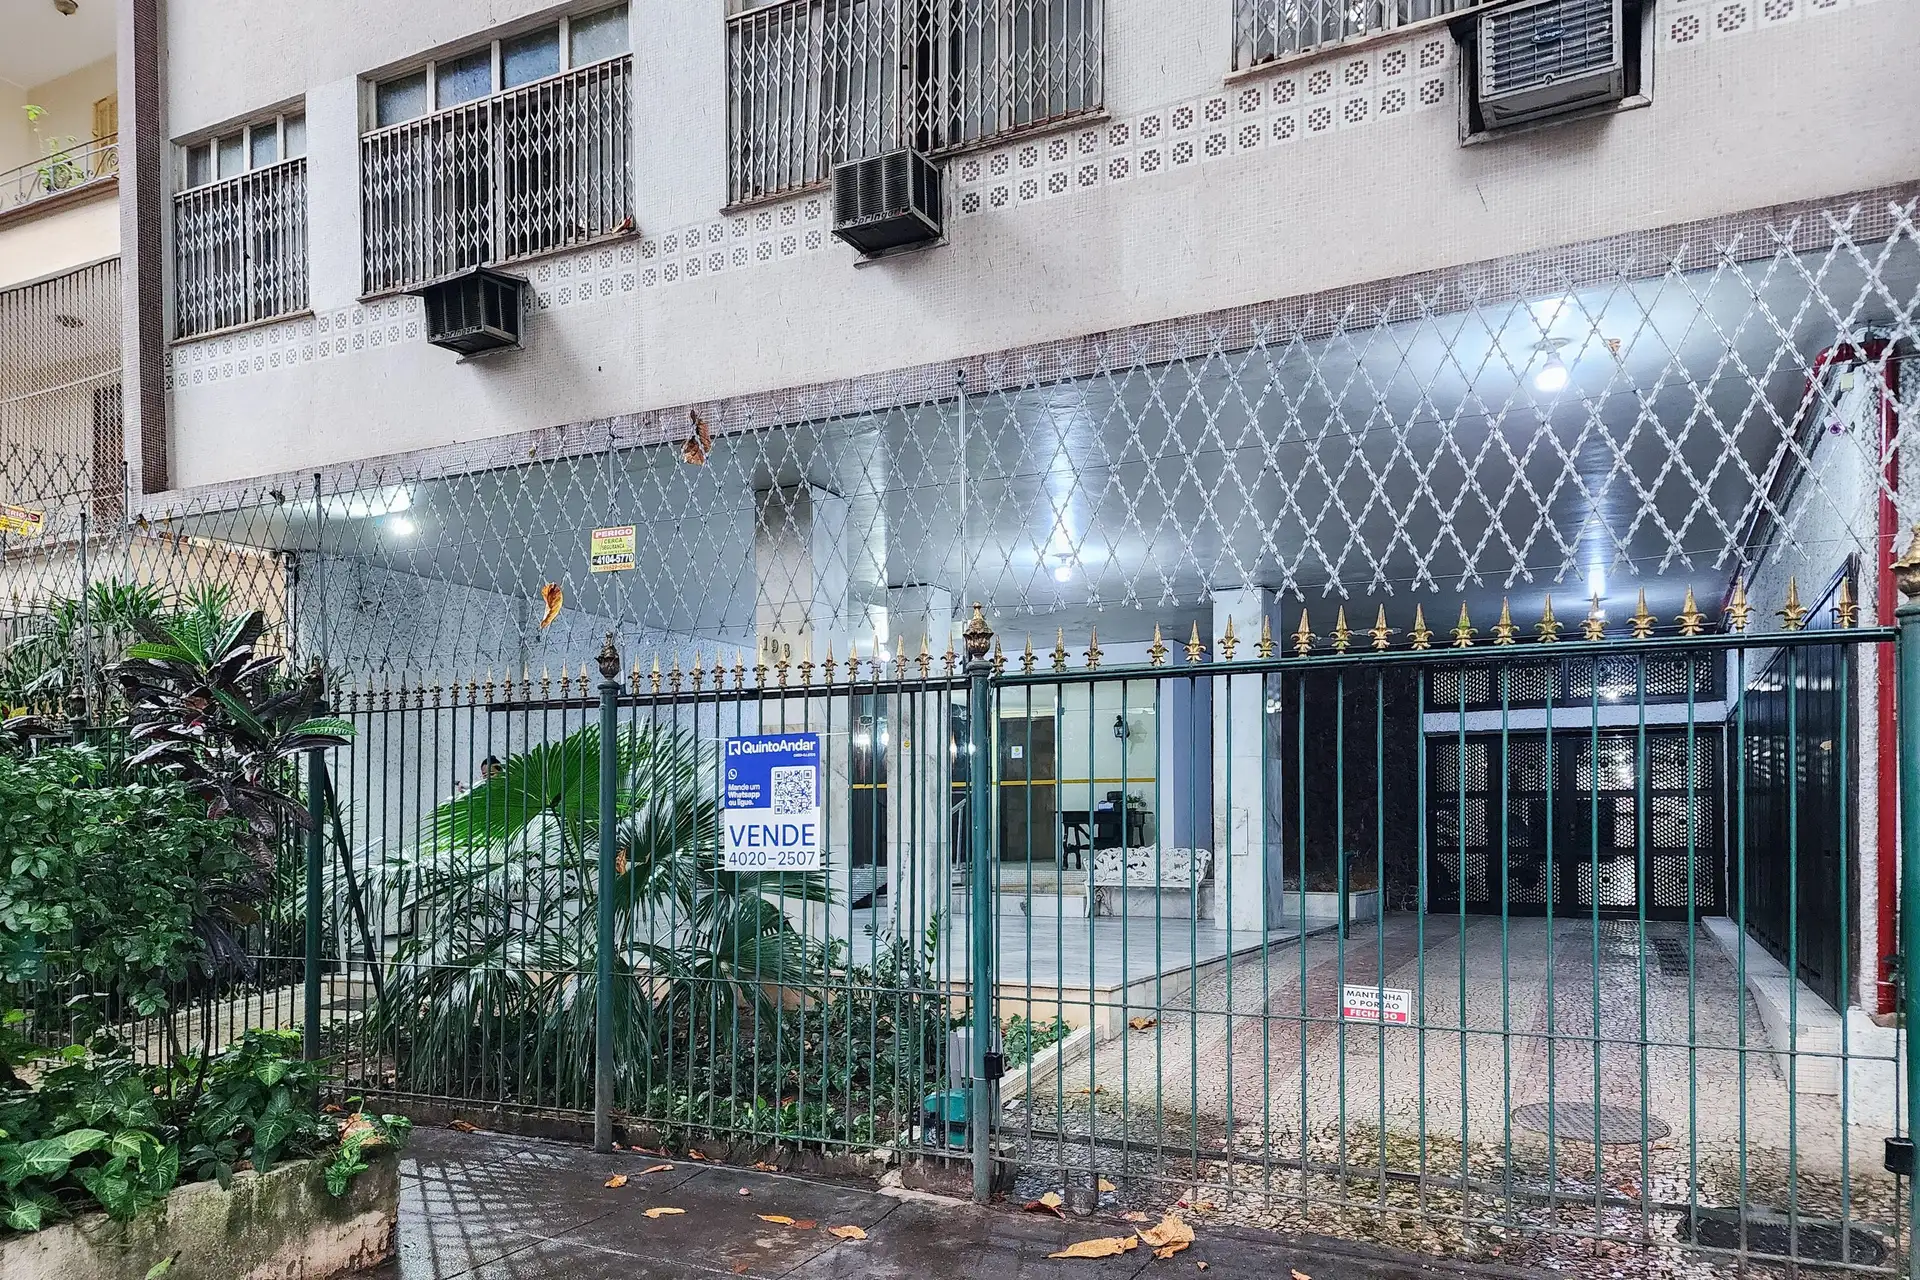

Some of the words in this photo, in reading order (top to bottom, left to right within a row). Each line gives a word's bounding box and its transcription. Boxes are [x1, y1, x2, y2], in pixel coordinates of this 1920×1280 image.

[595, 528, 632, 538] PERIGO
[742, 739, 816, 754] QuintoAndar
[728, 783, 749, 791] Mande
[729, 824, 815, 847] VENDE
[728, 851, 815, 866] 4020-2507
[1360, 1000, 1400, 1010] PORÃO
